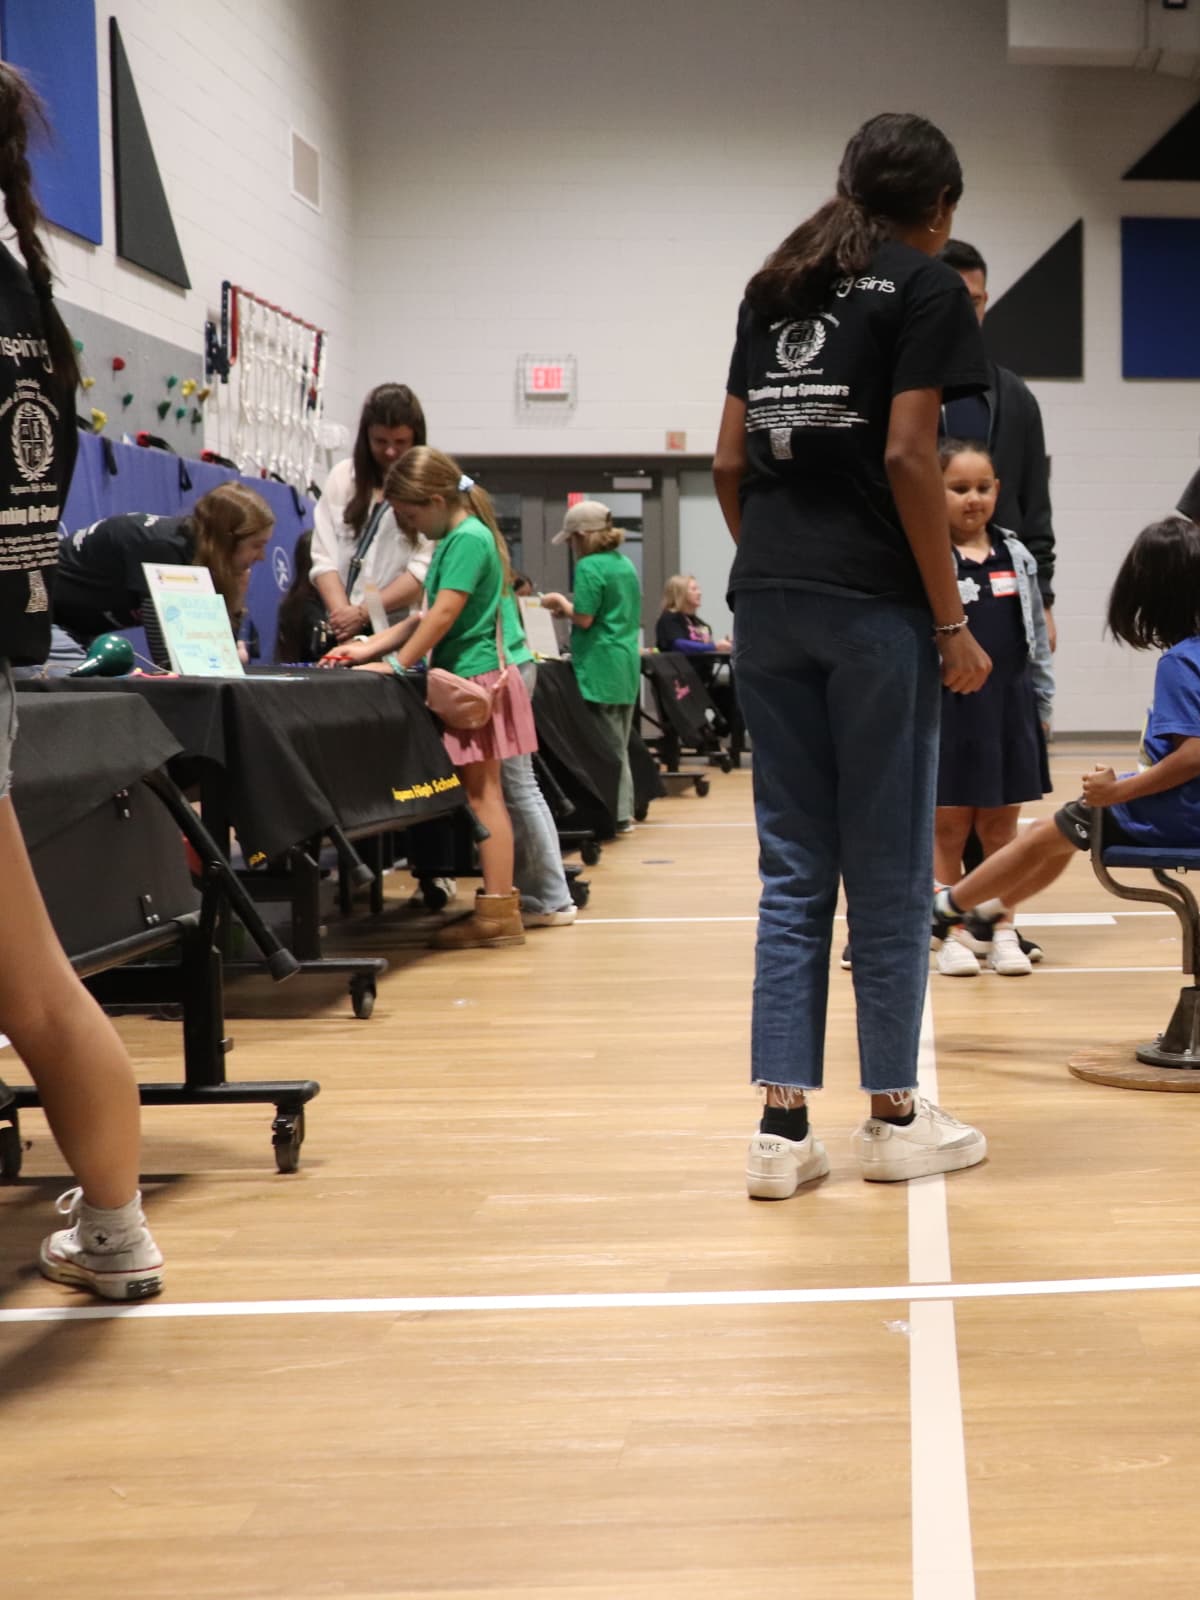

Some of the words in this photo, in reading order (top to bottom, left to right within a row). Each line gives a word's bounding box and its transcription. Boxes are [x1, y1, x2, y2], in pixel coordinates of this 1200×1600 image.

[855, 276, 896, 294] Girls
[0, 332, 54, 374] nspiring
[532, 367, 563, 390] EXIT
[798, 383, 850, 397] Sponsors
[758, 1142, 782, 1153] NIKE
